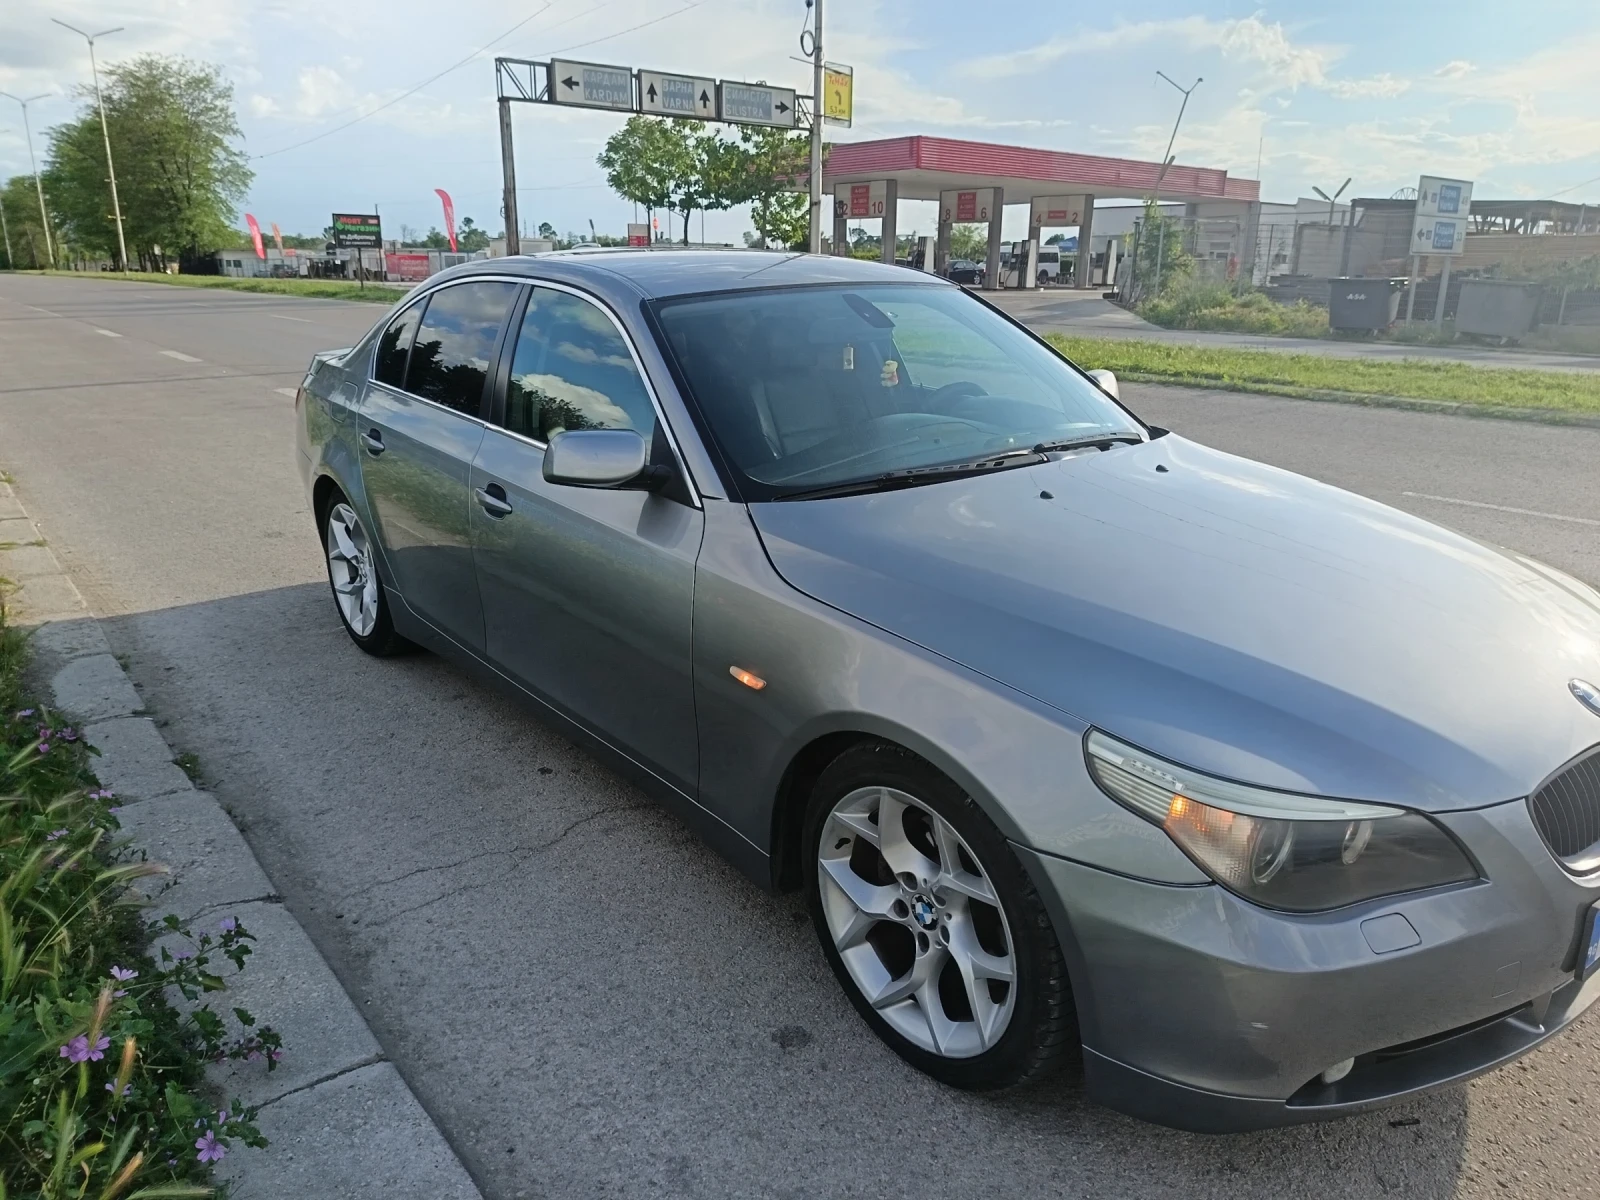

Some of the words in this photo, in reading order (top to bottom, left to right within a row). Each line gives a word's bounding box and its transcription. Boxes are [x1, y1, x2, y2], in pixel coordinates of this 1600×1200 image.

[584, 71, 627, 87] КАРДАМ
[663, 80, 694, 94] ВАРНА
[585, 88, 628, 103] KARDAM
[726, 88, 771, 103] СИЛИСТРА
[664, 97, 695, 110] VARNA
[726, 105, 764, 118] SILISTRA
[871, 201, 883, 214] 10
[945, 208, 951, 220] 8
[980, 207, 987, 219] 6
[1035, 213, 1042, 224] 4
[1071, 212, 1079, 223] 2
